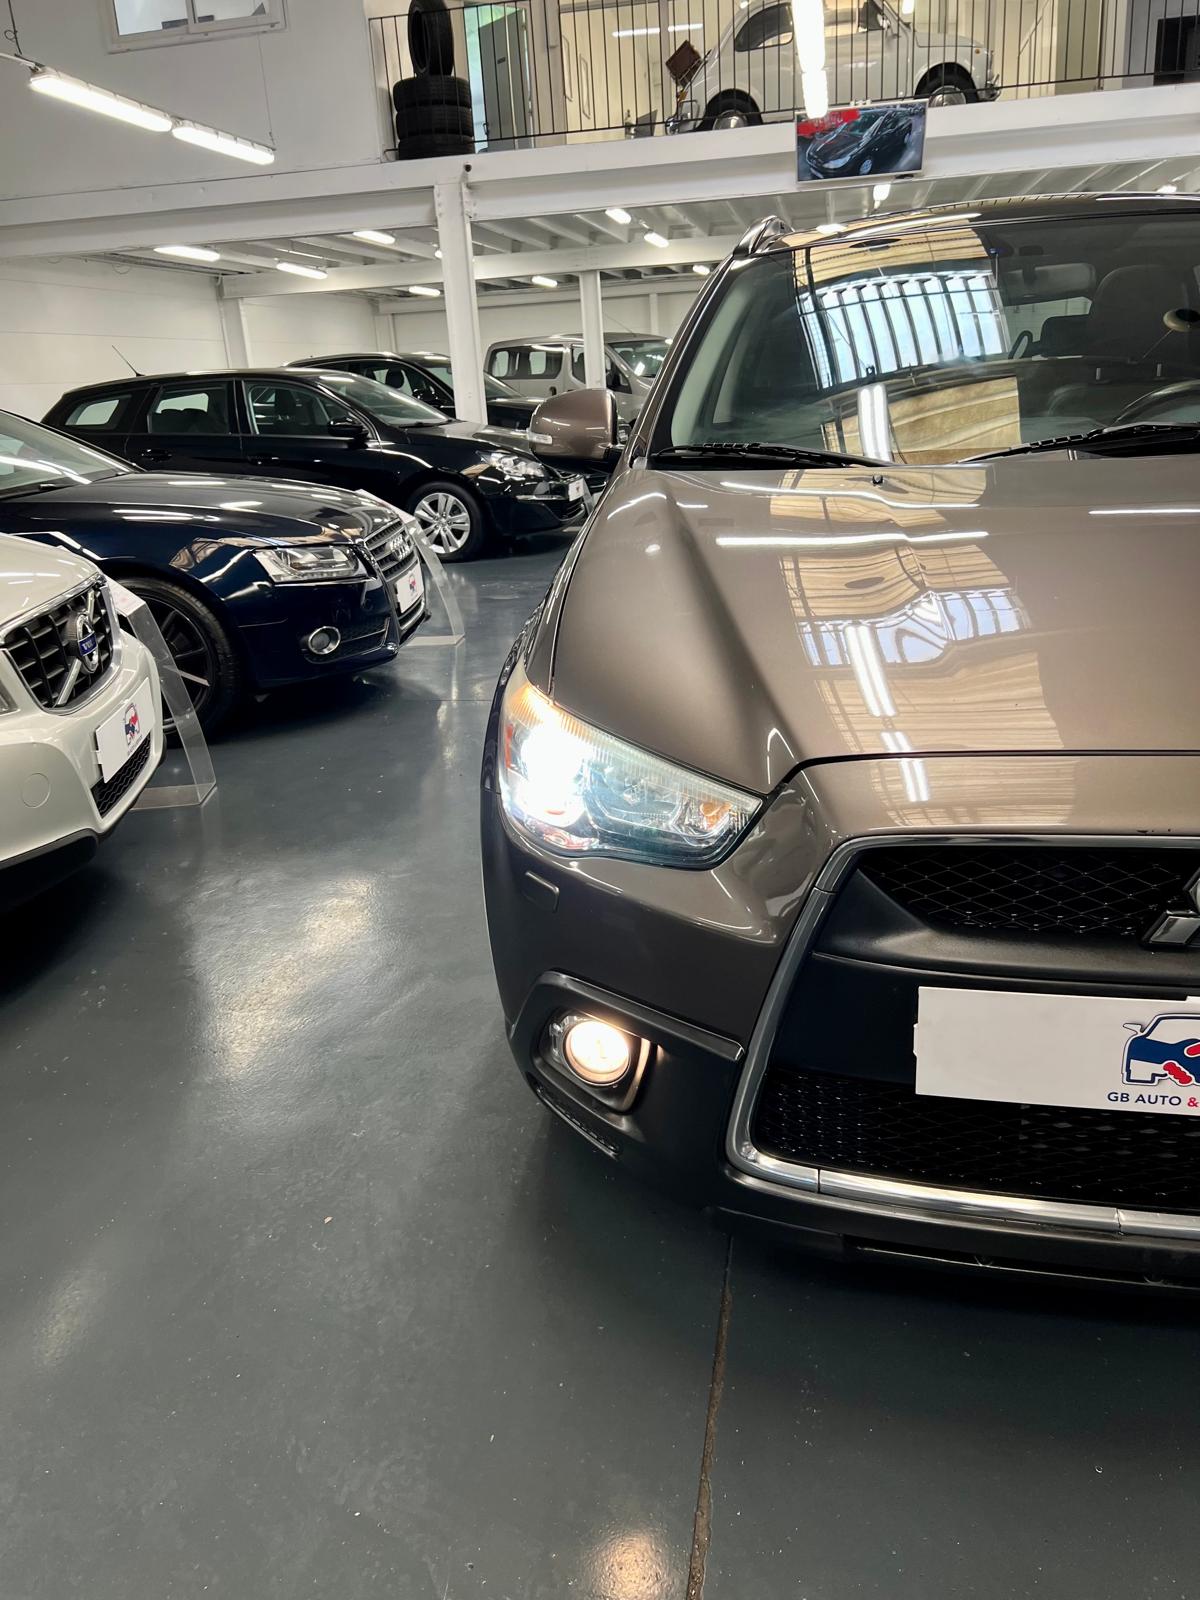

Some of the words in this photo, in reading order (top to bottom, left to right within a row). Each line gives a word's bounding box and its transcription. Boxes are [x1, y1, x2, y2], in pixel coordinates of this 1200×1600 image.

[1107, 1091, 1130, 1103] GB
[1135, 1094, 1182, 1106] AUTO
[1187, 1097, 1199, 1107] &
